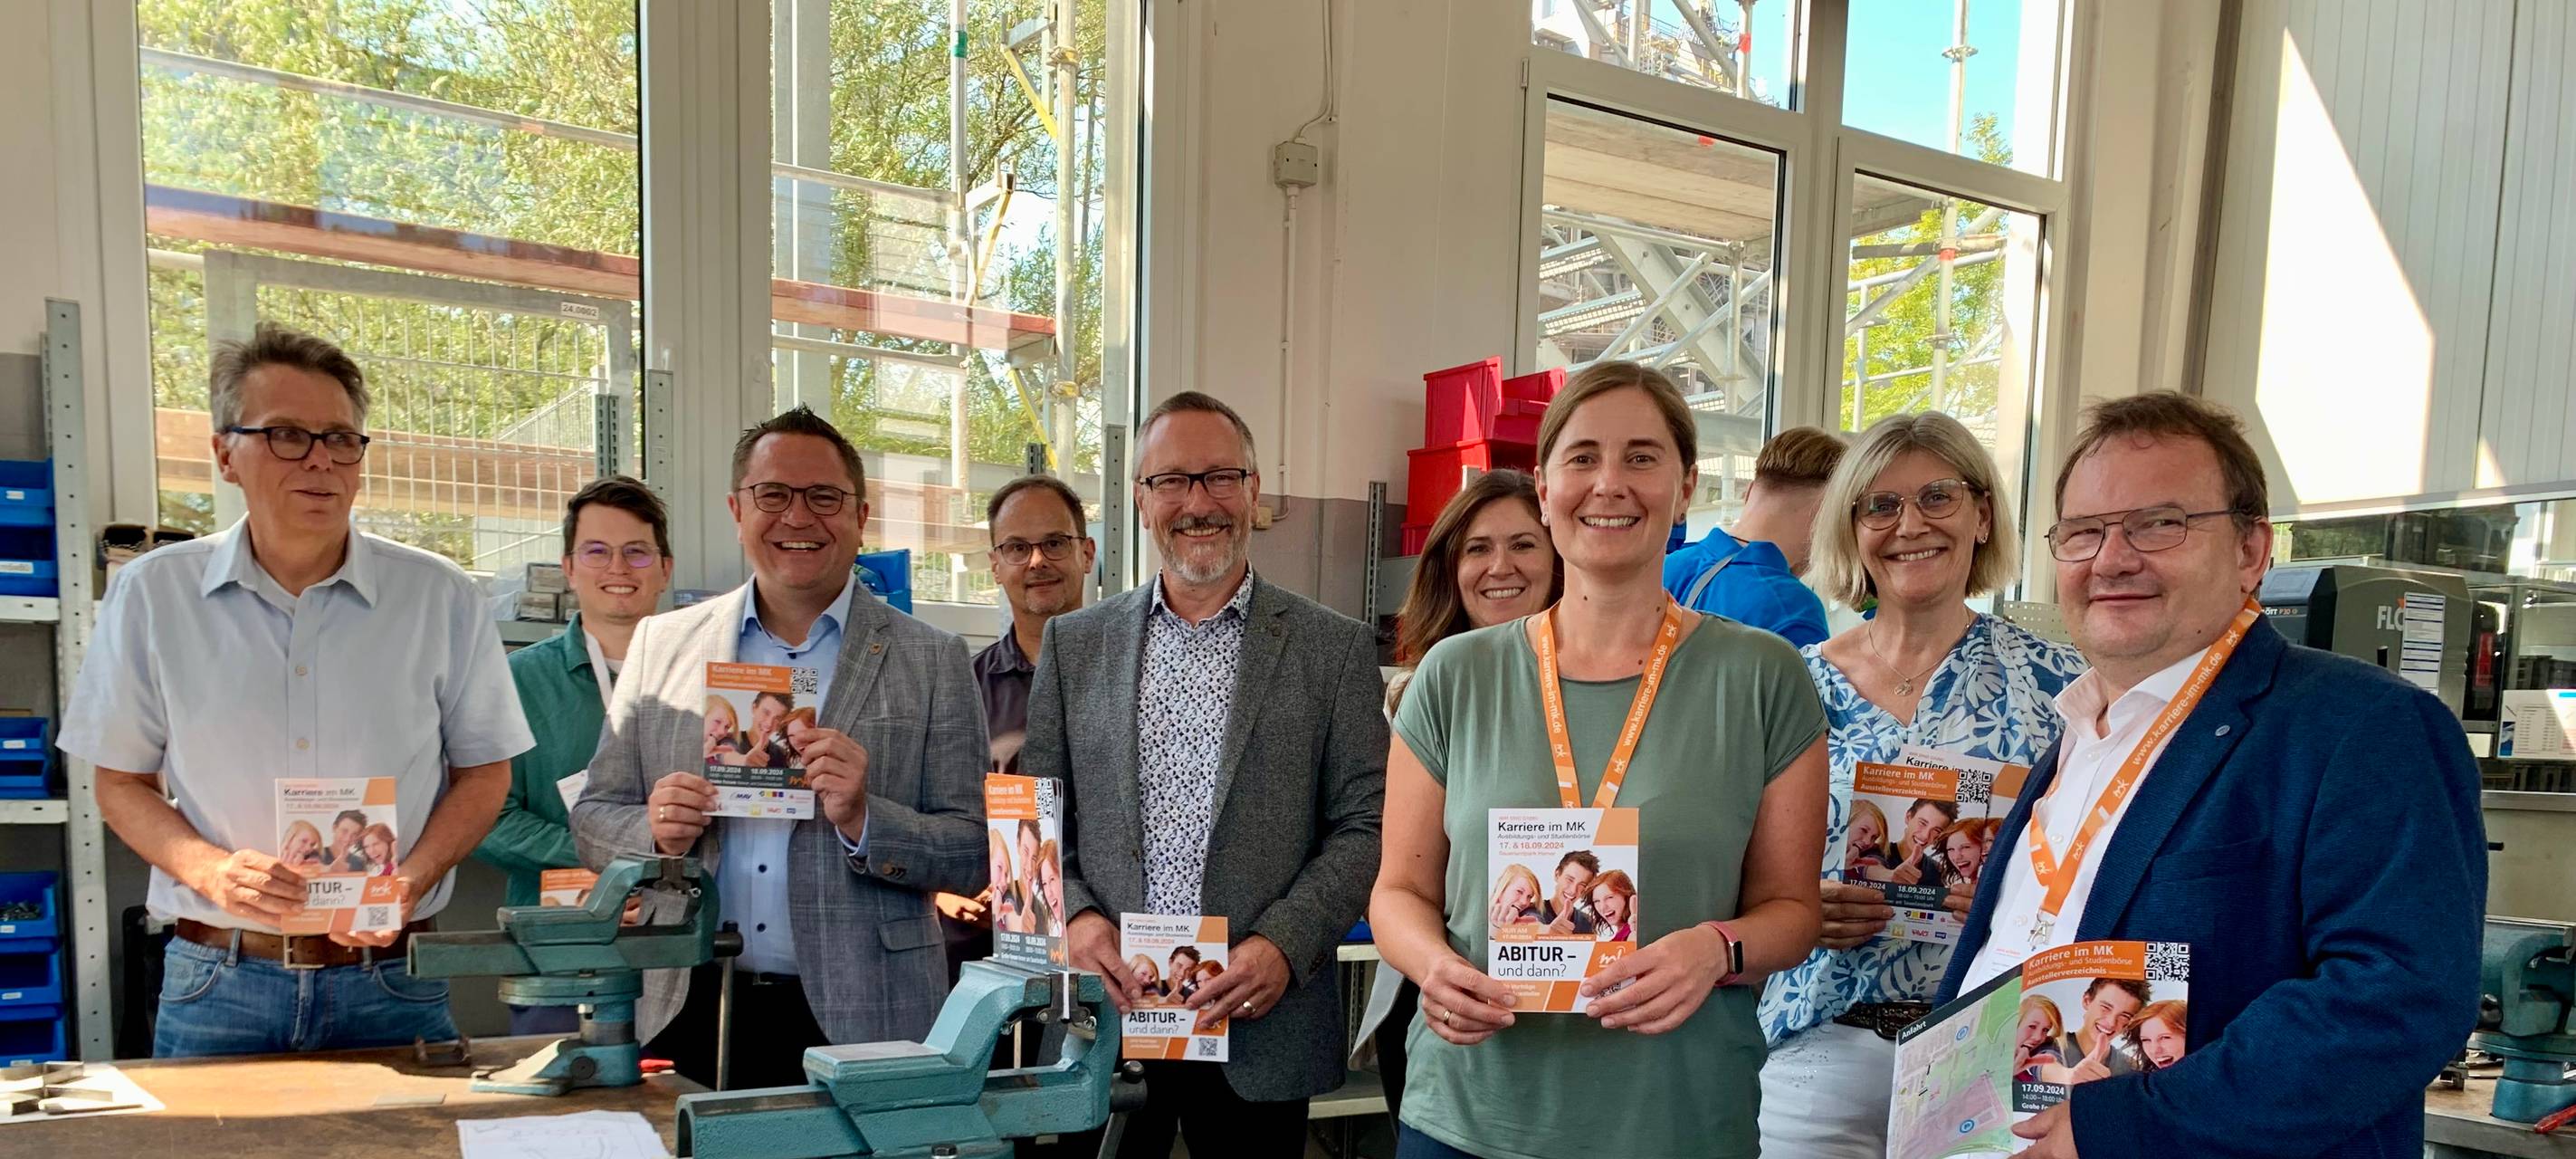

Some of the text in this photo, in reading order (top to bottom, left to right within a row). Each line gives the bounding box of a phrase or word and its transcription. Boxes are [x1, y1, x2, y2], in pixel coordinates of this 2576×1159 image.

[1541, 635, 1562, 734] www.karriere-im-mk.de
[1623, 644, 1668, 747] www.karriere-im-mk.de
[2132, 651, 2223, 766] www.karriere-im-mk.de
[1906, 756, 1949, 771] Karriere
[1863, 766, 1935, 781] Karriere im MK
[1498, 821, 1586, 832] Karriere im MK
[307, 882, 342, 895] ITUR
[1897, 885, 1936, 895] 18.09.2024
[1127, 922, 1190, 933] Karriere im MK
[1497, 946, 1563, 962] ABITUR
[2028, 949, 2071, 969] Karriere
[2074, 946, 2089, 957] im
[2093, 945, 2114, 956] MK
[2069, 956, 2084, 965] und
[2085, 956, 2133, 966] Studienbörse
[1498, 963, 1567, 977] und dann?
[2027, 966, 2107, 986] Ausstellerverzeichnis
[1129, 1011, 1177, 1023] ABITUR
[1129, 1024, 1179, 1035] und dann?
[1901, 1020, 1927, 1040] Anfahrt
[2021, 1084, 2065, 1095] 17.09.2024
